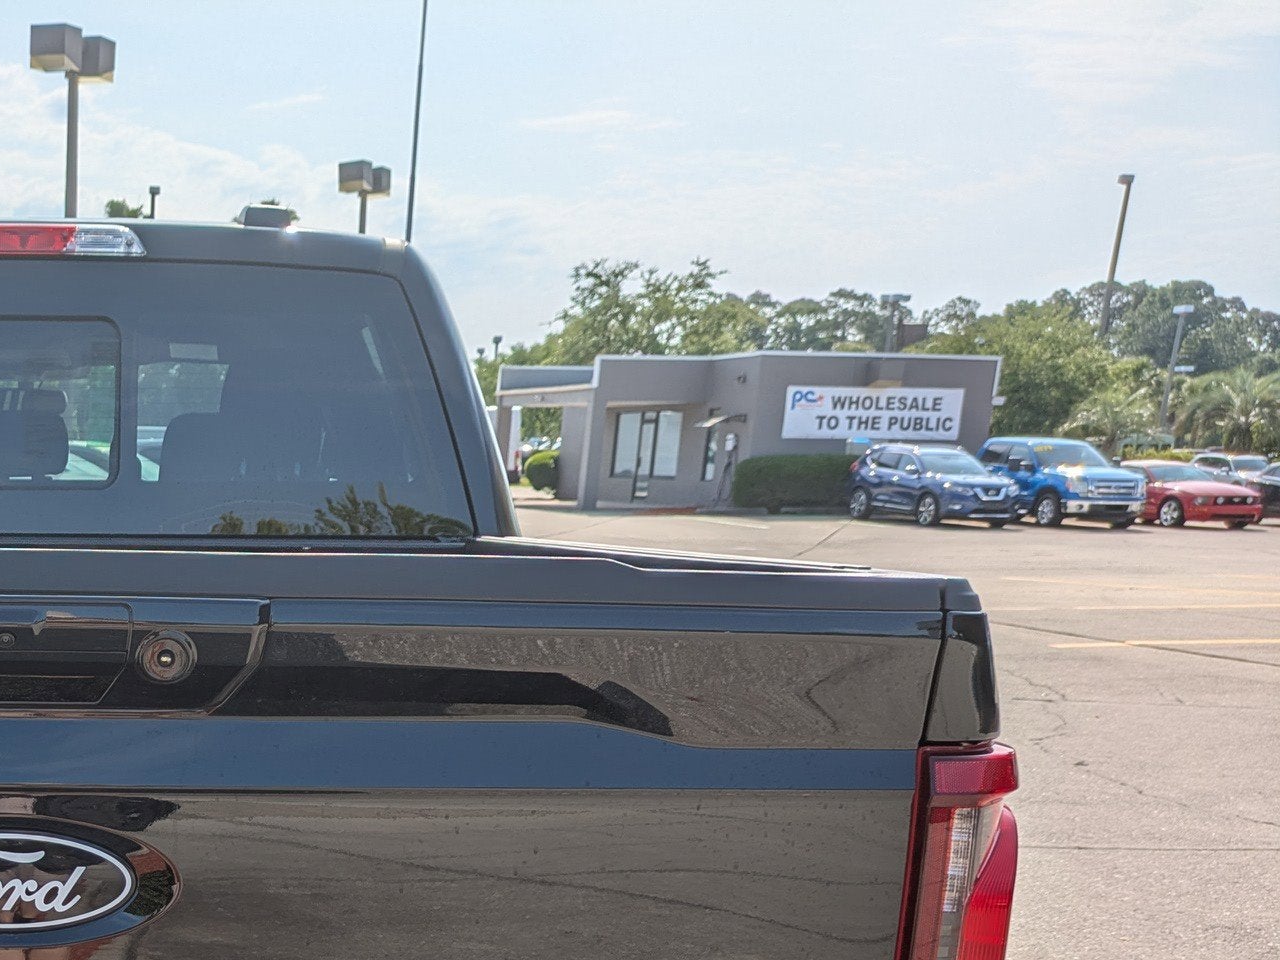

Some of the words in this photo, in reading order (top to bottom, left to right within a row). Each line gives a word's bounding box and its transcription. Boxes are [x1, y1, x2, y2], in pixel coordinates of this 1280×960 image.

[831, 396, 943, 412] WHOLESALE
[815, 415, 840, 431] TO
[846, 416, 882, 431] THE
[887, 416, 953, 432] PUBLIC
